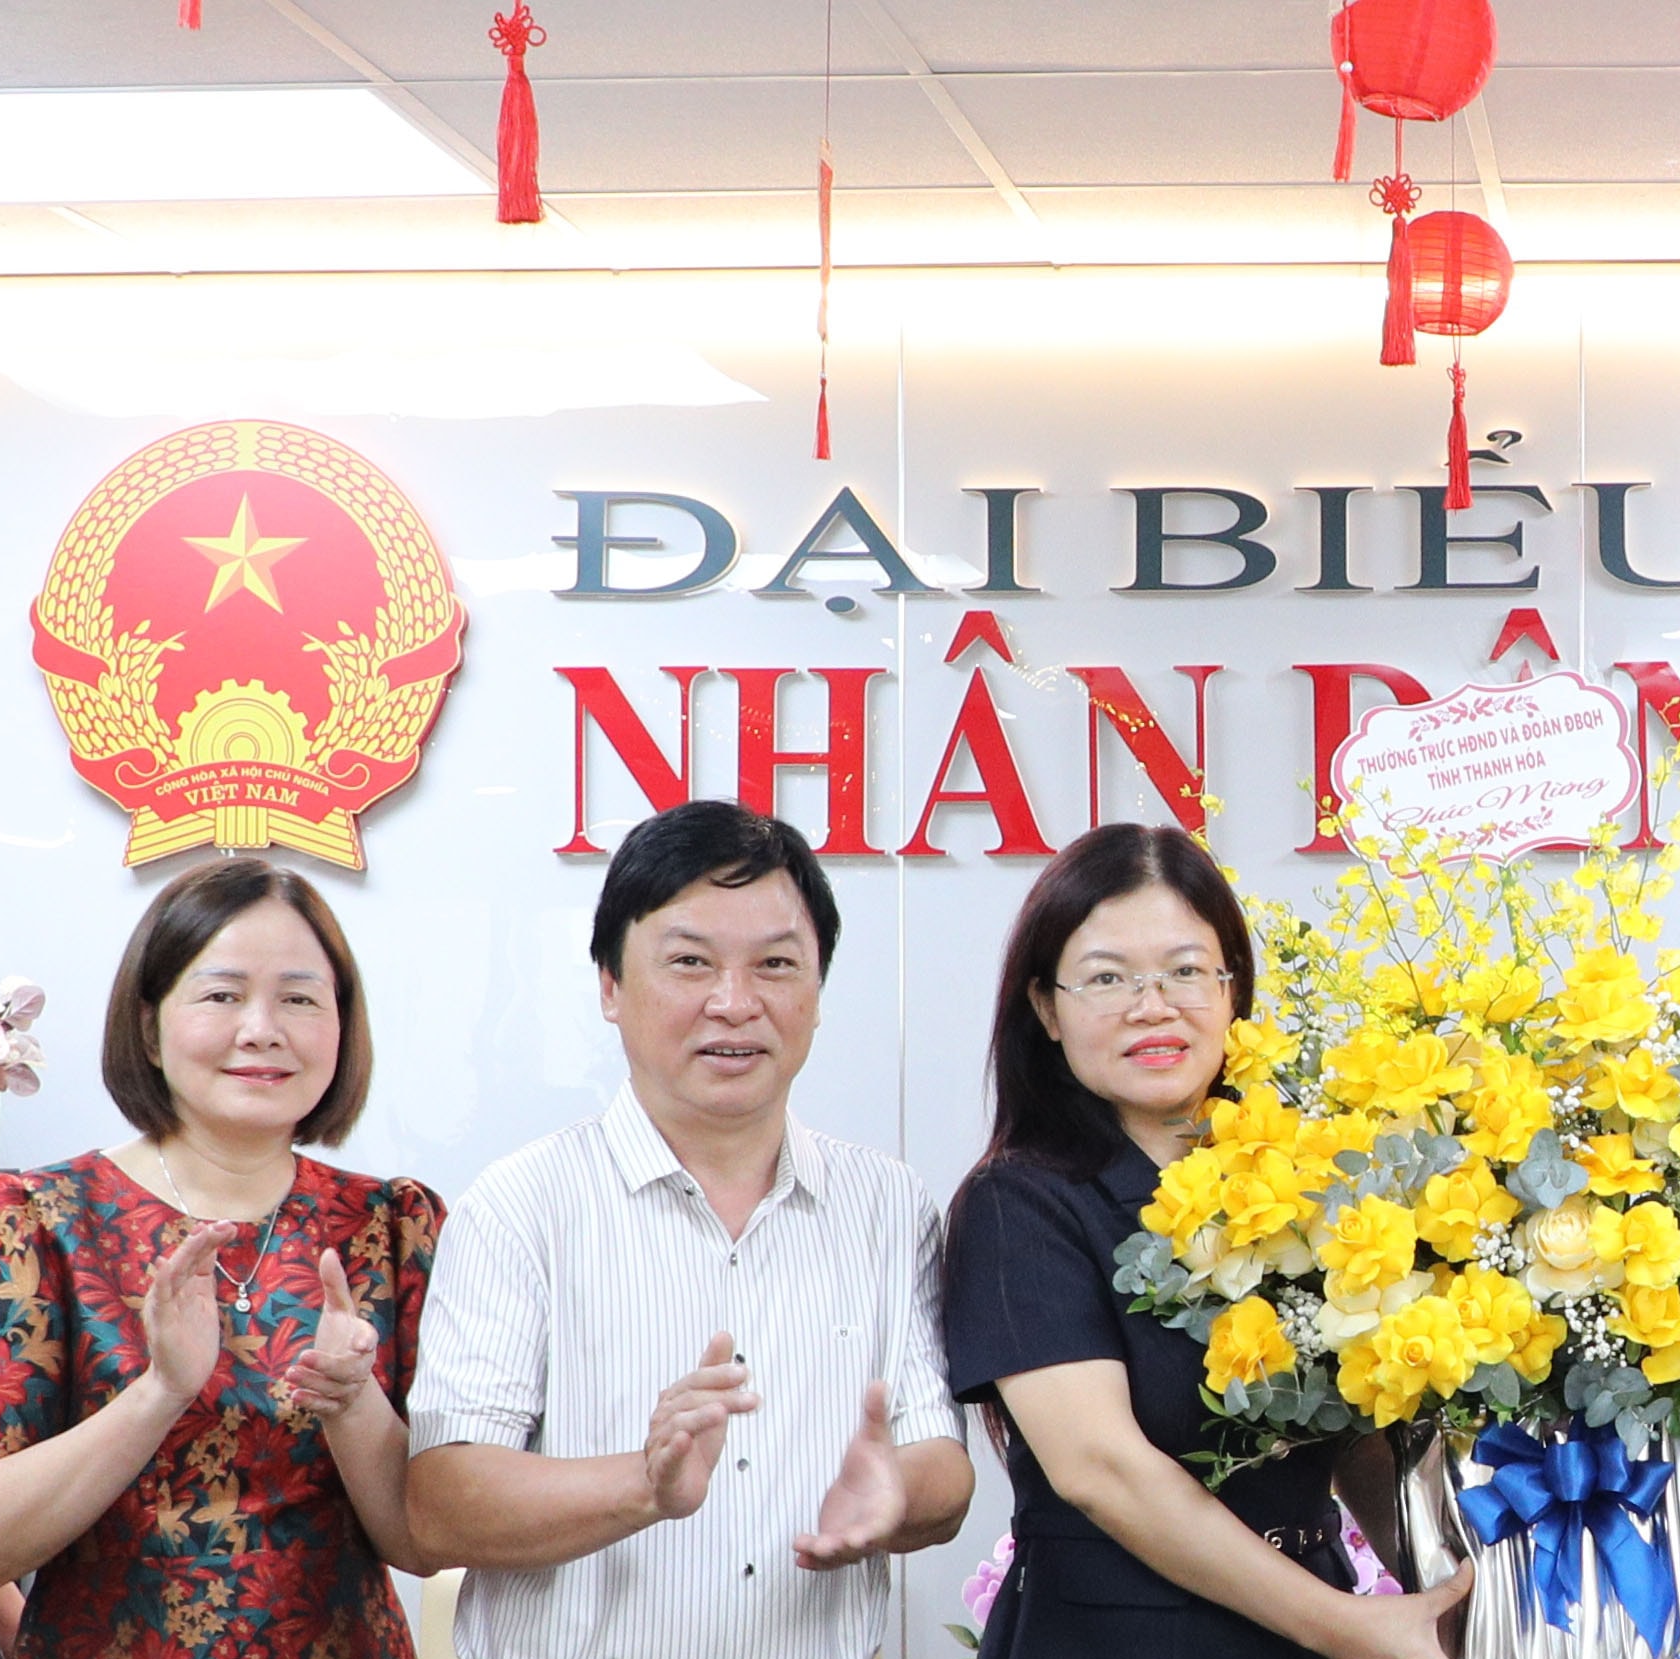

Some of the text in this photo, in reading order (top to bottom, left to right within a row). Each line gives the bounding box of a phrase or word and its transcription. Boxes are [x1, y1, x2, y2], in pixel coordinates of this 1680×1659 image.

[551, 486, 1044, 615] ĐẠI
[552, 609, 1228, 856] NHÂN
[1357, 708, 1604, 775] THƯỜNG TRỰC HĐND VÀ ĐOÀN ĐBQH
[1463, 757, 1513, 783] THANH
[1515, 746, 1546, 772] HÓA
[184, 780, 300, 807] VIỆT NAM
